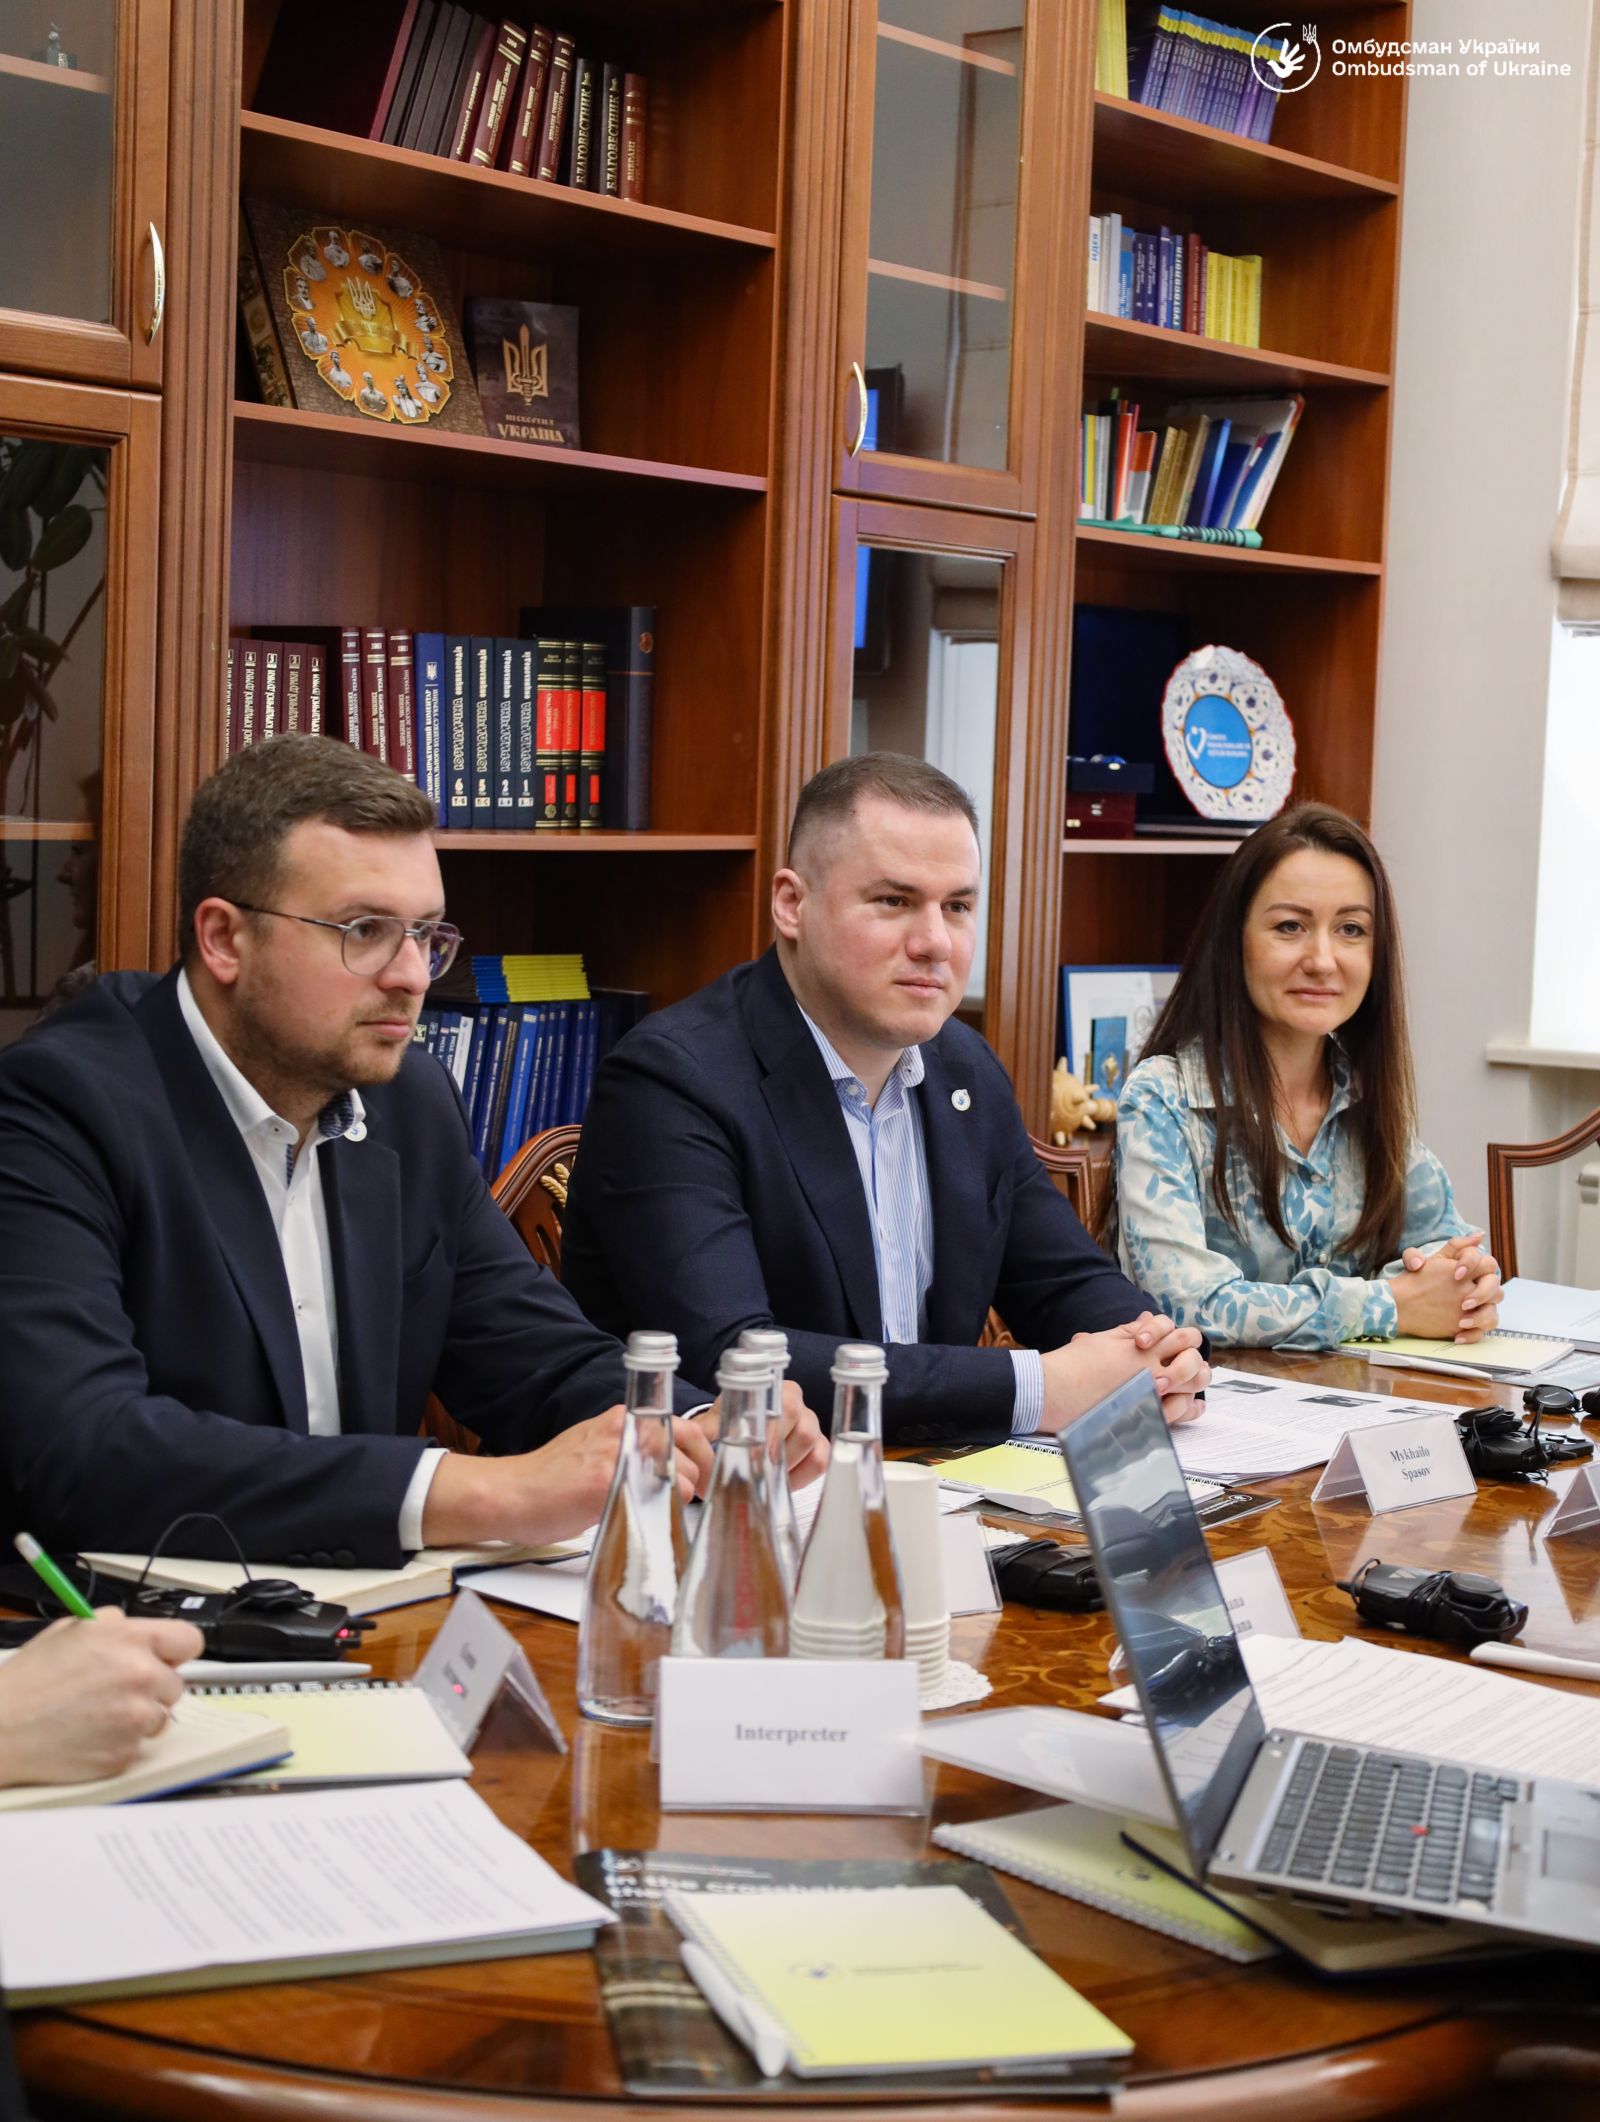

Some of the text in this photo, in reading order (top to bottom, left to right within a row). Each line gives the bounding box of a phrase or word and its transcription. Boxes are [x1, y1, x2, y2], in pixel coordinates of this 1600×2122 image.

[576, 88, 592, 184] БЛАГОВЕСТНИК
[607, 93, 620, 192] БЛАГОВЕСТНИК
[496, 422, 566, 444] УКРАЇНА
[246, 669, 254, 691] ДУМКИ
[267, 669, 275, 692] ДУМКИ
[290, 671, 299, 693] ДУМКИ
[312, 674, 321, 696] ДУМКИ
[452, 646, 464, 771] ЮРИДИЧНА енциклопедія
[476, 648, 488, 773] ЮРИДИЧНА енциклопедія
[500, 649, 512, 773] ЮРИДИЧНА енциклопедія
[520, 651, 532, 773] ЮРИДИЧНА енциклопедія
[454, 778, 464, 791] 6
[478, 778, 486, 792] 5
[502, 779, 509, 792] 2
[523, 779, 529, 792] 1
[1390, 1445, 1430, 1464] Mykhailo
[1401, 1467, 1431, 1482] Spasov
[736, 1723, 850, 1746] Interpreter
[644, 1875, 698, 1890] the
